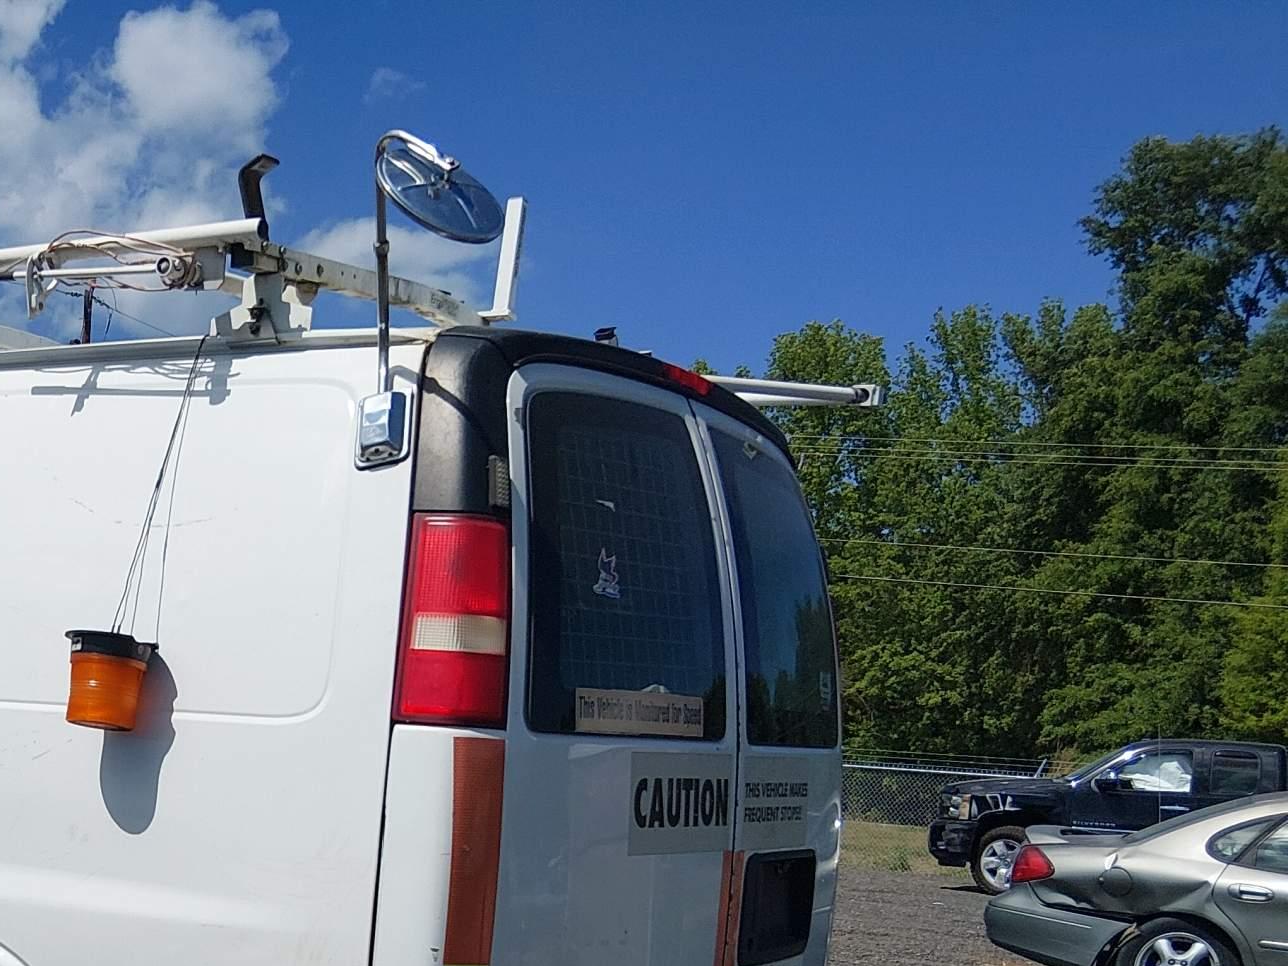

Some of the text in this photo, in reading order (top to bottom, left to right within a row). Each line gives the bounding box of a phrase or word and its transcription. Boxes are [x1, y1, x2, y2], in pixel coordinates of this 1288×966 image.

[578, 695, 595, 720] This
[596, 696, 624, 721] Vehicle
[625, 698, 633, 721] is
[671, 702, 682, 724] for
[744, 782, 808, 799] THIS VEHICLE MAKES
[634, 777, 729, 829] CAUTION
[743, 806, 779, 824] FREQUENT
